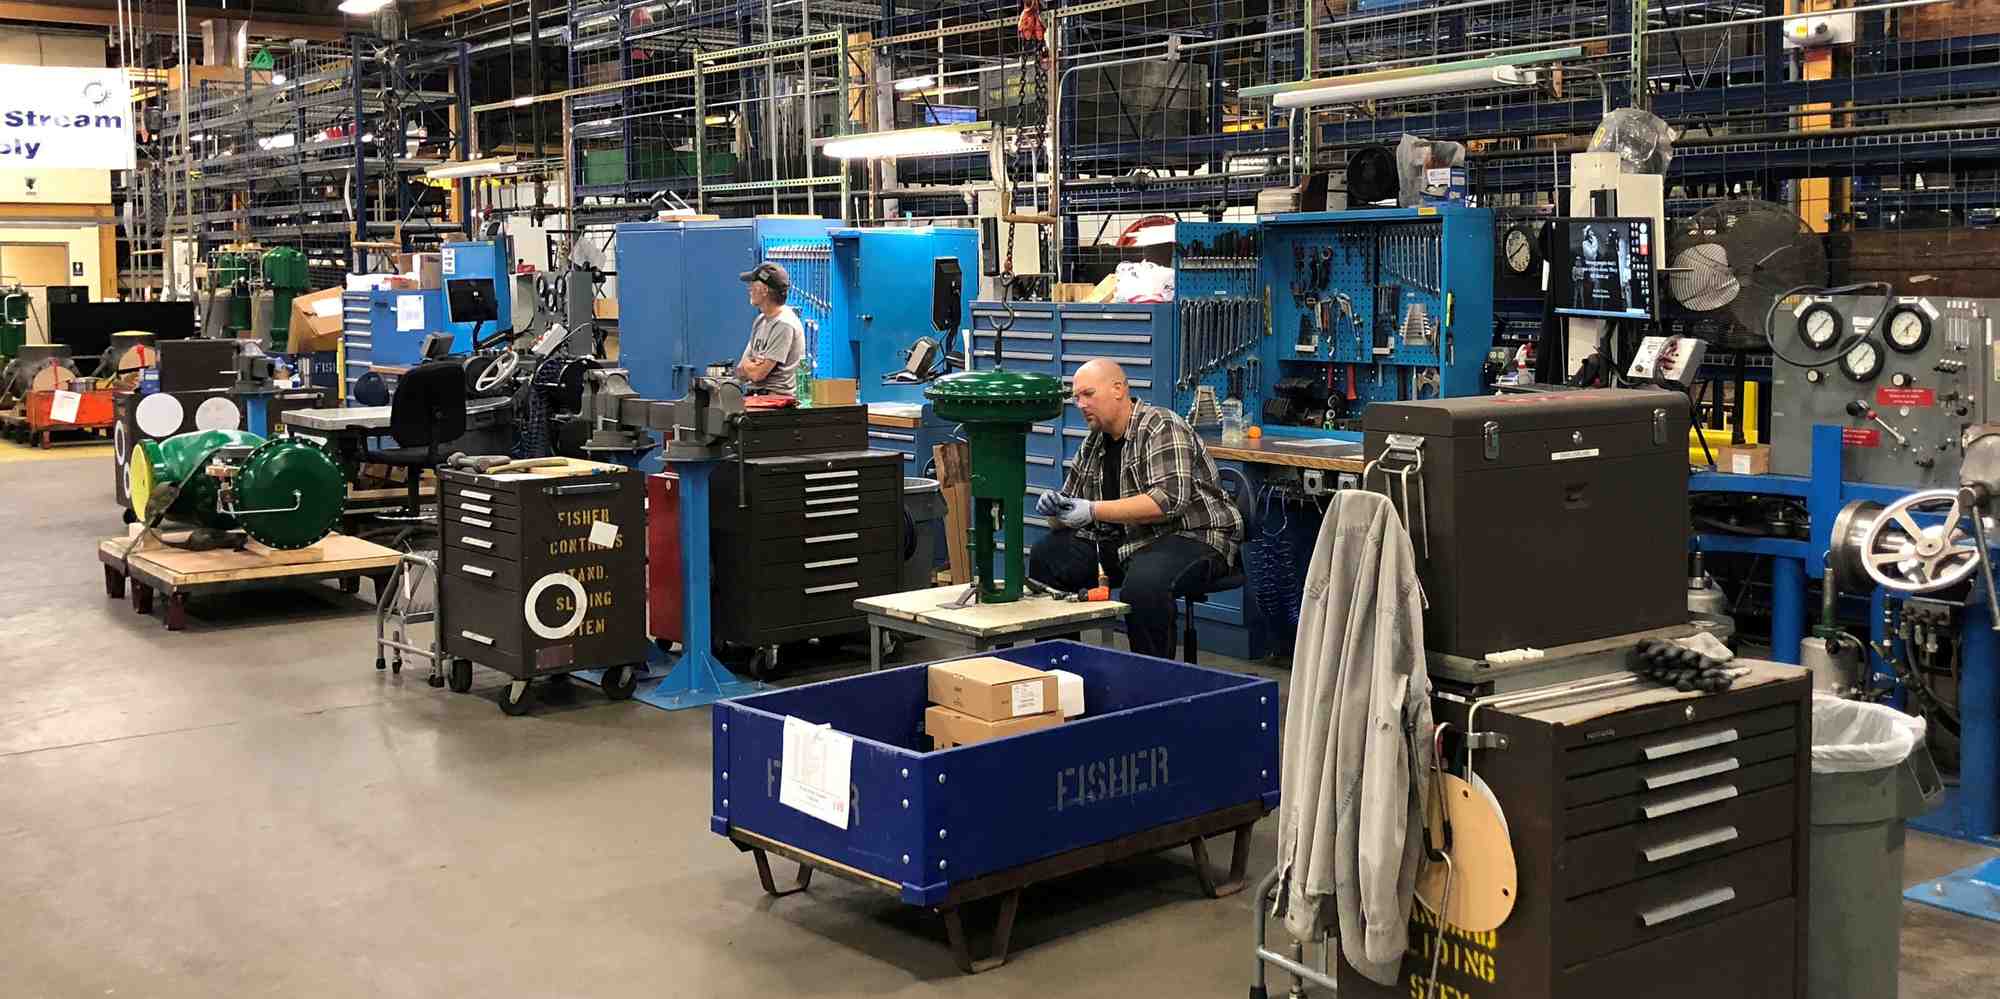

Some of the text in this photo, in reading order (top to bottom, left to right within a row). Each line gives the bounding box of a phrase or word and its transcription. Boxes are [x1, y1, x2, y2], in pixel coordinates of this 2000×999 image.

[561, 564, 609, 582] TAND.
[556, 591, 612, 612] SLING
[1057, 745, 1169, 811] FISHER
